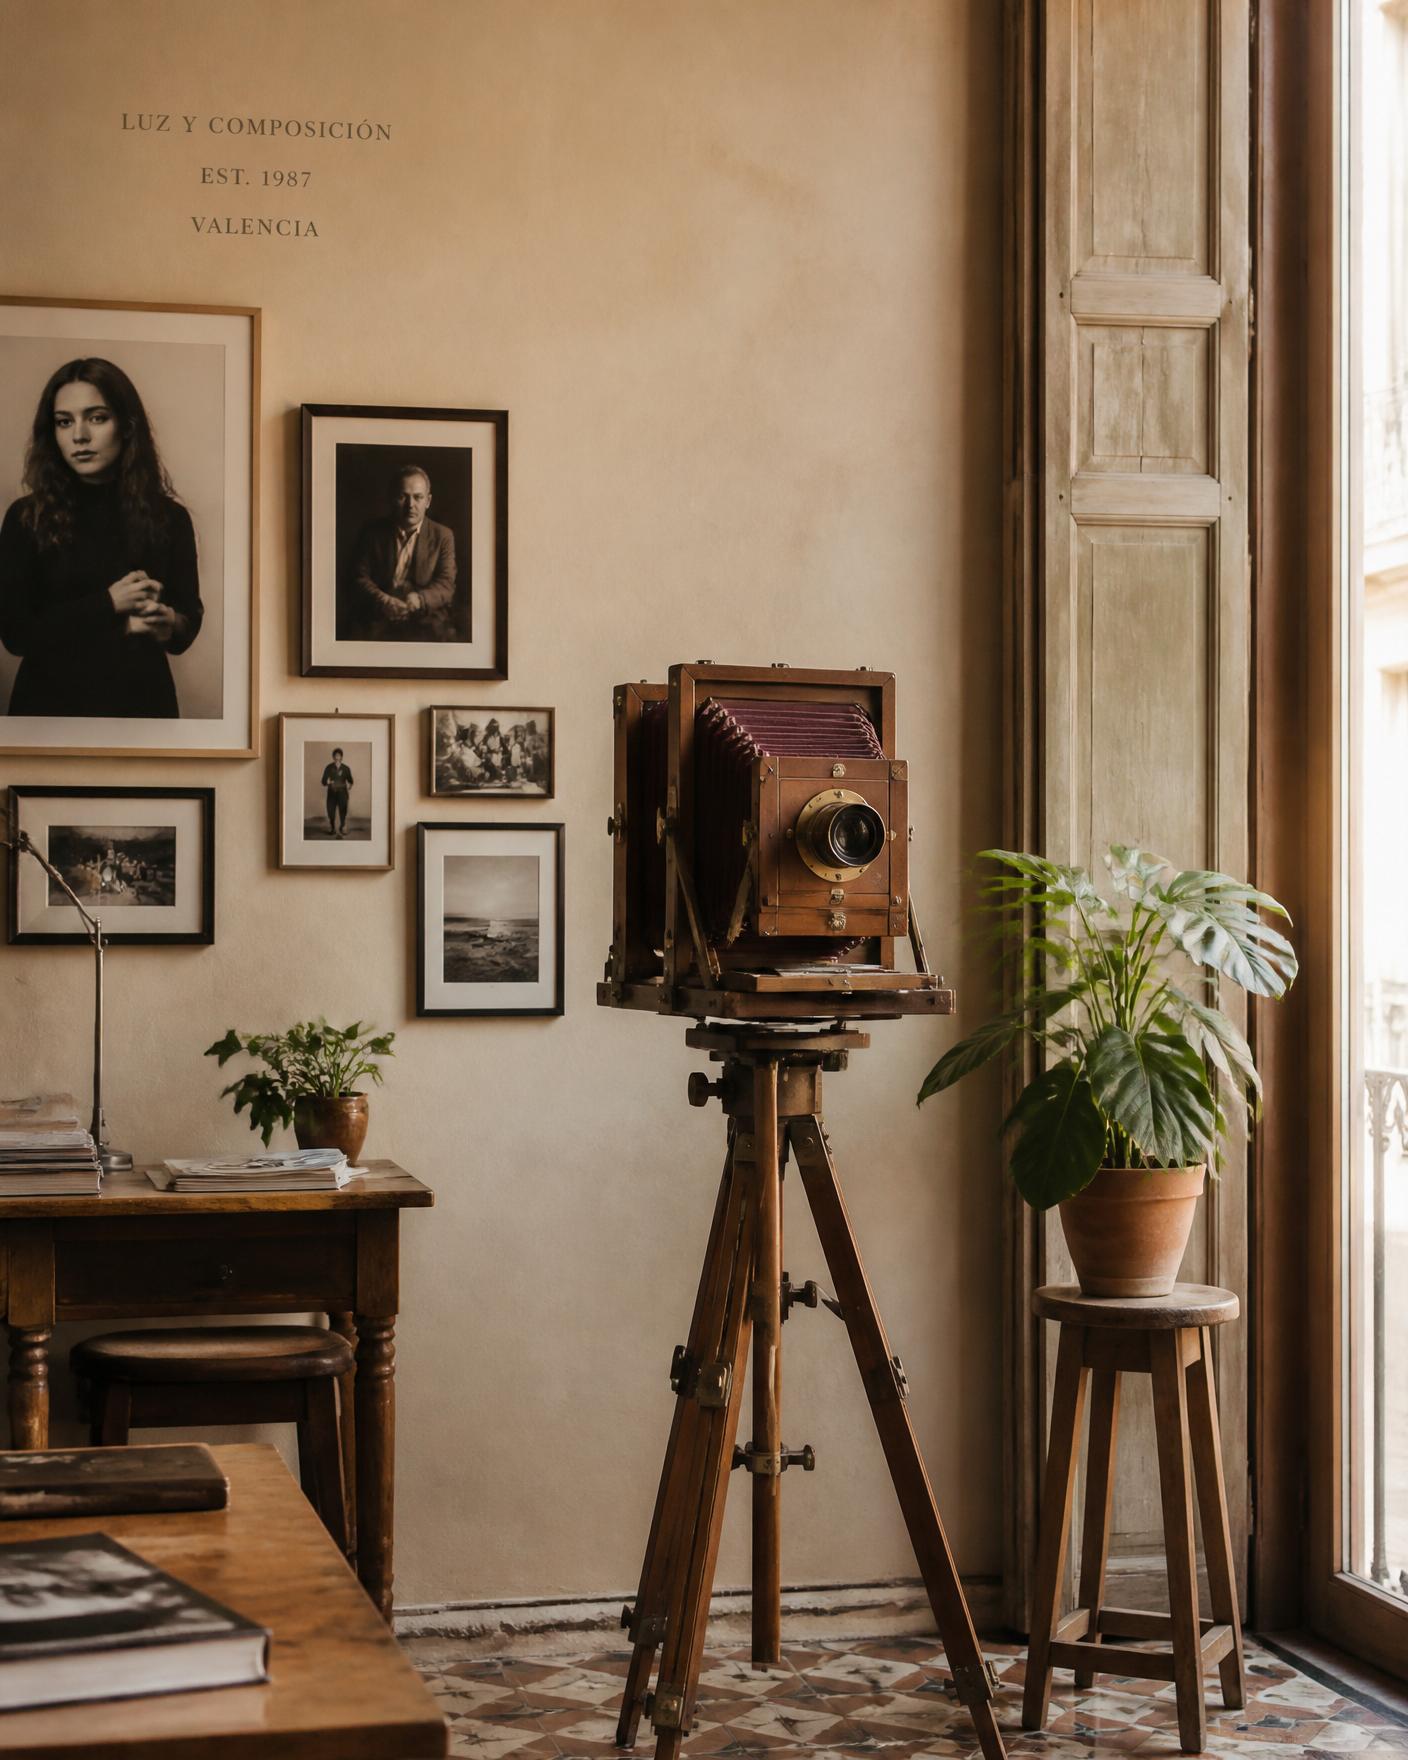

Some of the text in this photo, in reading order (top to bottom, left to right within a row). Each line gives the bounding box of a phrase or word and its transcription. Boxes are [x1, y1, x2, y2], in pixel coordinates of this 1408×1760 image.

[121, 113, 393, 141] LUZ Y COMPOSICIÓN
[200, 167, 312, 188] EST. 1987
[190, 216, 320, 238] VALENCIA
